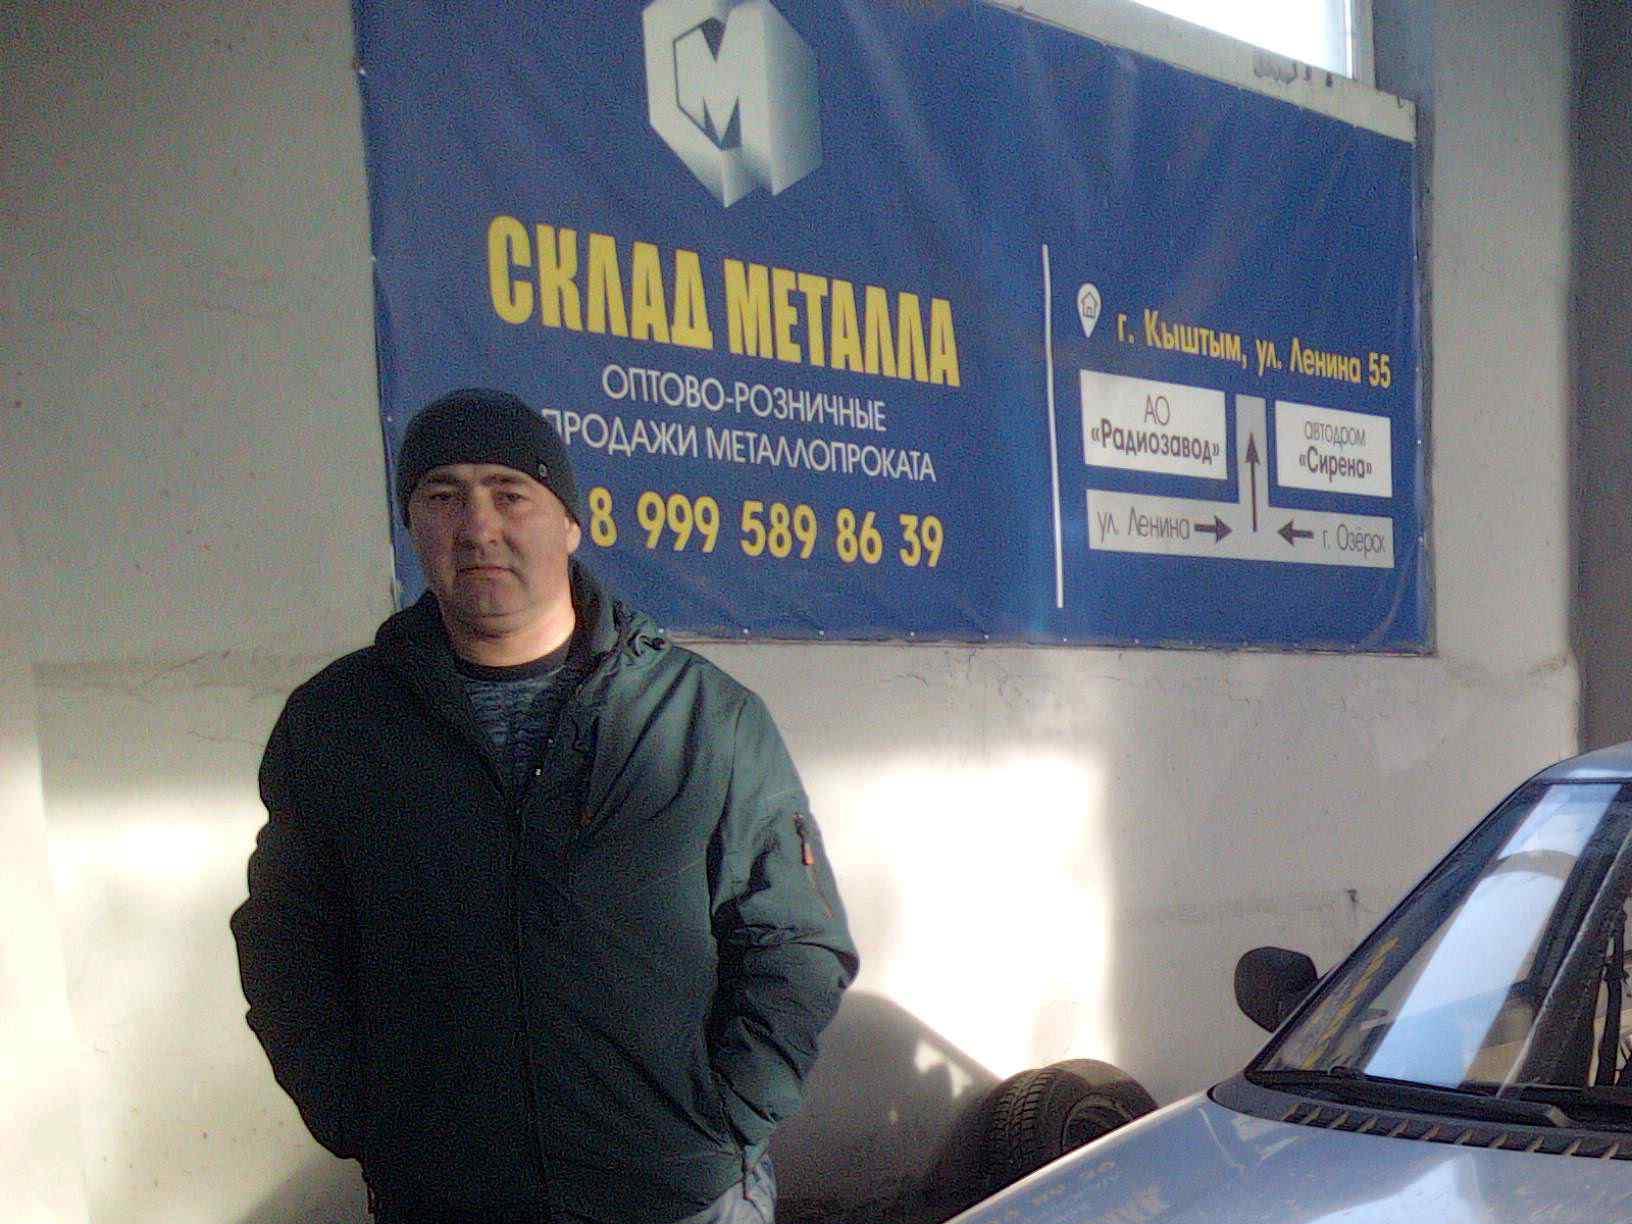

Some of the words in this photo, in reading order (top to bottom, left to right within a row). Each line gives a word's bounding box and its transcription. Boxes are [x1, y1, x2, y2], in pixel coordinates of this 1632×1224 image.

[487, 216, 713, 350] СКЛАД
[723, 258, 960, 387] МЕТАЛЛА
[1116, 313, 1135, 343] г.
[1144, 309, 1248, 368] Кыштым,
[1256, 339, 1283, 376] ул.
[1289, 337, 1361, 386] Ленина
[1368, 351, 1391, 389] 55
[601, 363, 887, 432] ОПТОВО-РОЗНИЧНЫЕ
[1143, 394, 1171, 426] АО
[706, 427, 936, 482] МЕТАЛЛОПРОКАТА
[1091, 418, 1220, 465] «Радиозавод»
[1299, 446, 1373, 483] «Сирена»
[589, 486, 618, 548] 8
[636, 490, 721, 553] 999
[740, 500, 818, 560] 589
[835, 506, 883, 566] 86
[899, 513, 943, 568] 39
[1128, 506, 1190, 540] Ленина
